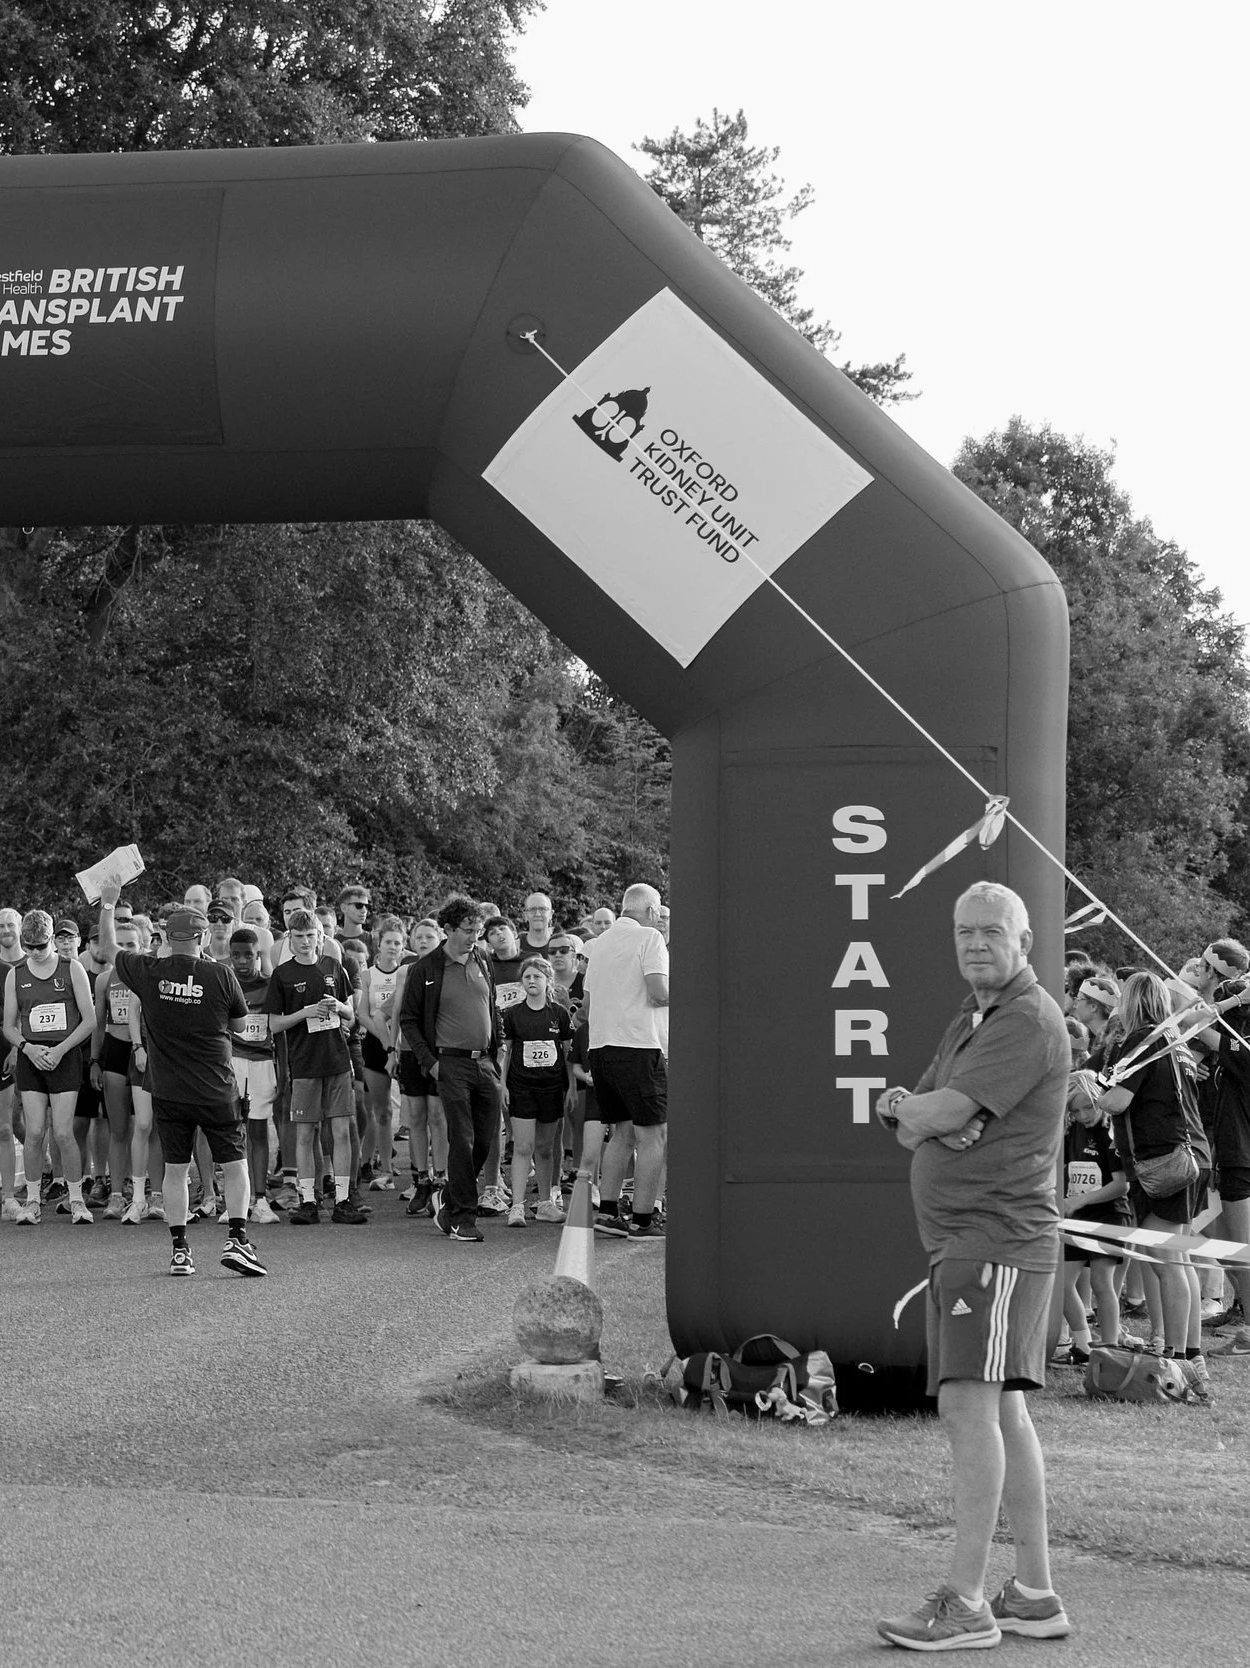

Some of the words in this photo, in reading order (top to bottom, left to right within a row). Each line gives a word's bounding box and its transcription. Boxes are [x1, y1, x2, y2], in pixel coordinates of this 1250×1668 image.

[2, 283, 43, 295] Health
[48, 265, 185, 294] BRITISH
[660, 429, 739, 502] OXFORD
[643, 442, 714, 507] KIDNEY
[711, 504, 760, 548] UNIT
[629, 457, 691, 514] TRUST
[685, 512, 740, 564] FUND
[831, 805, 891, 1124] START
[170, 975, 204, 998] mls
[503, 991, 518, 1002] 122
[39, 1014, 56, 1024] 237
[532, 1051, 549, 1060] 226
